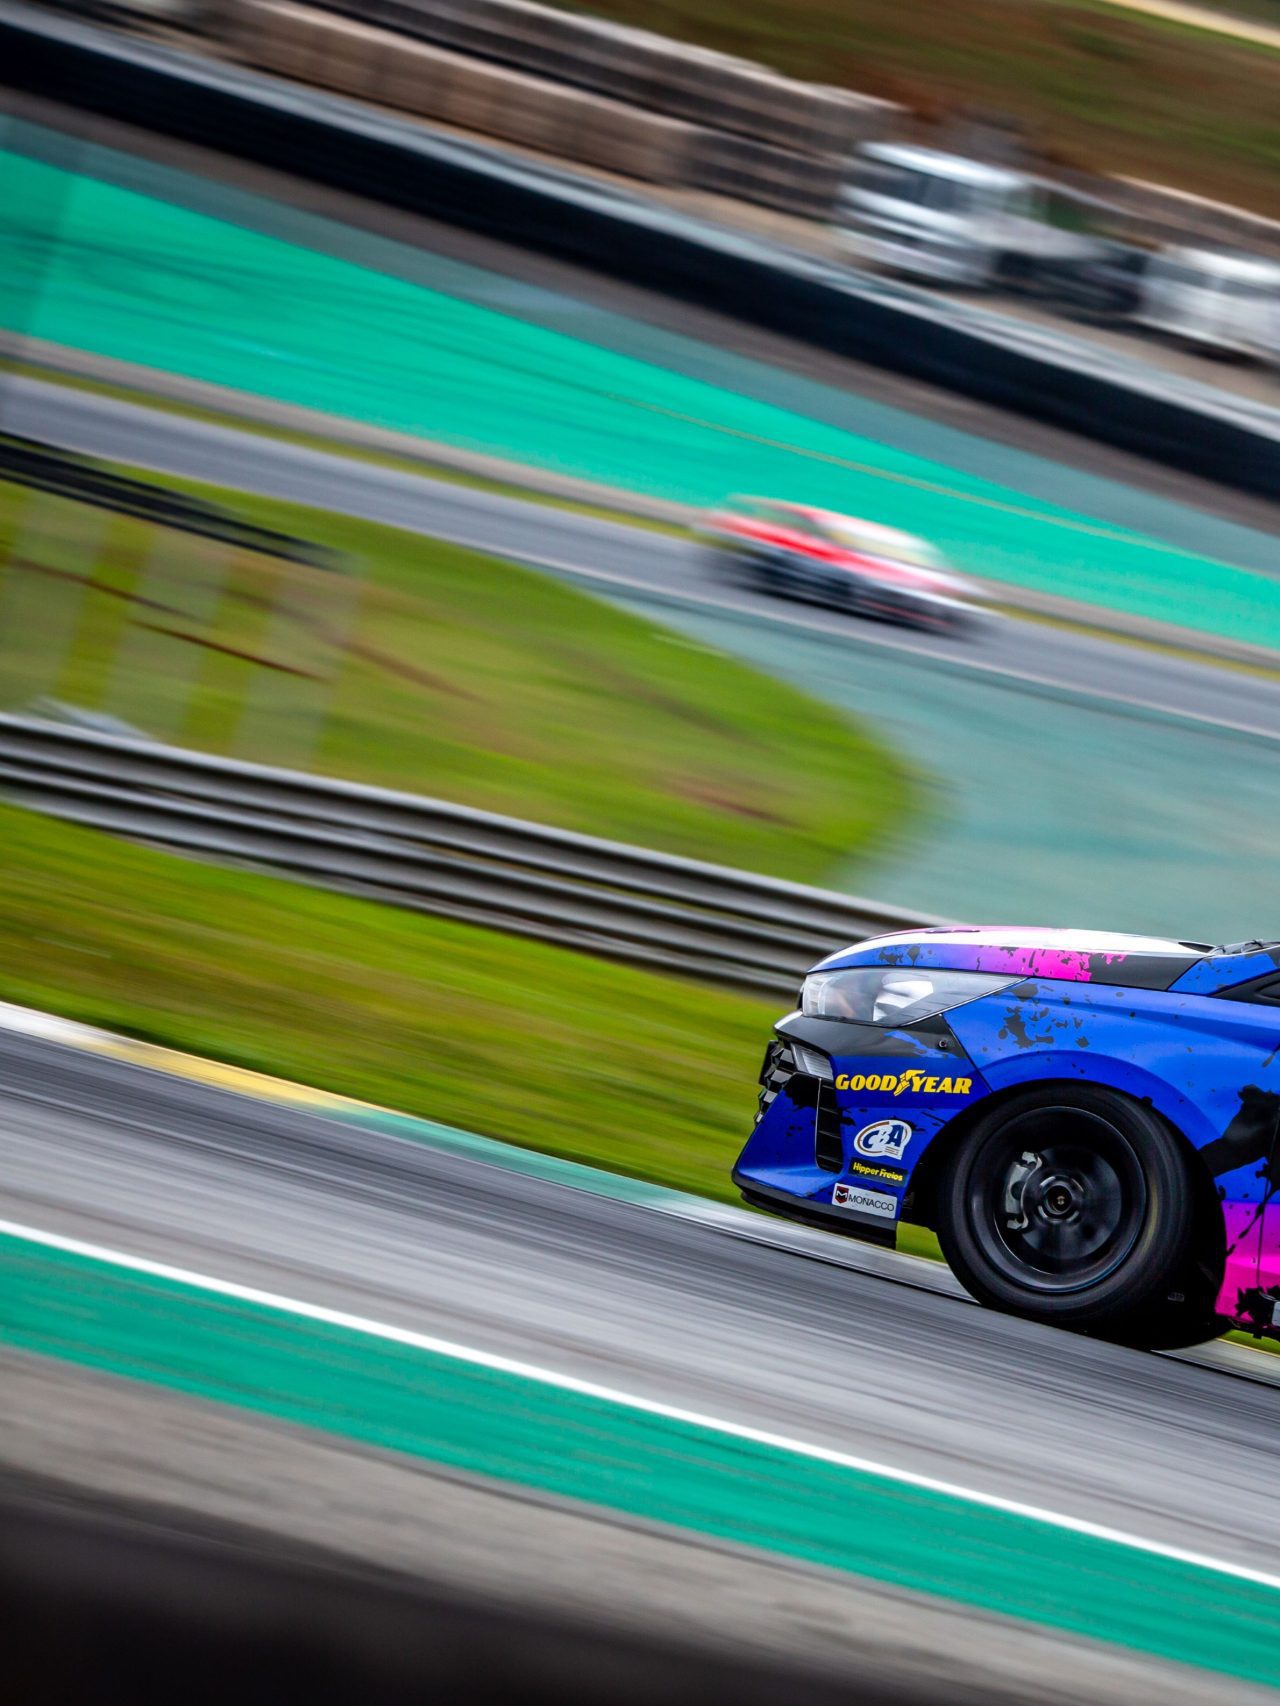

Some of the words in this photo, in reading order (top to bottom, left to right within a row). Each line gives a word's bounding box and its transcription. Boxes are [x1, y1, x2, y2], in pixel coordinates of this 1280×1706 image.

[835, 1069, 973, 1096] GOODYEAR
[862, 1124, 904, 1149] CBA
[853, 1162, 879, 1176] Hipper
[879, 1168, 903, 1182] Freios
[848, 1194, 895, 1212] MONACCO
